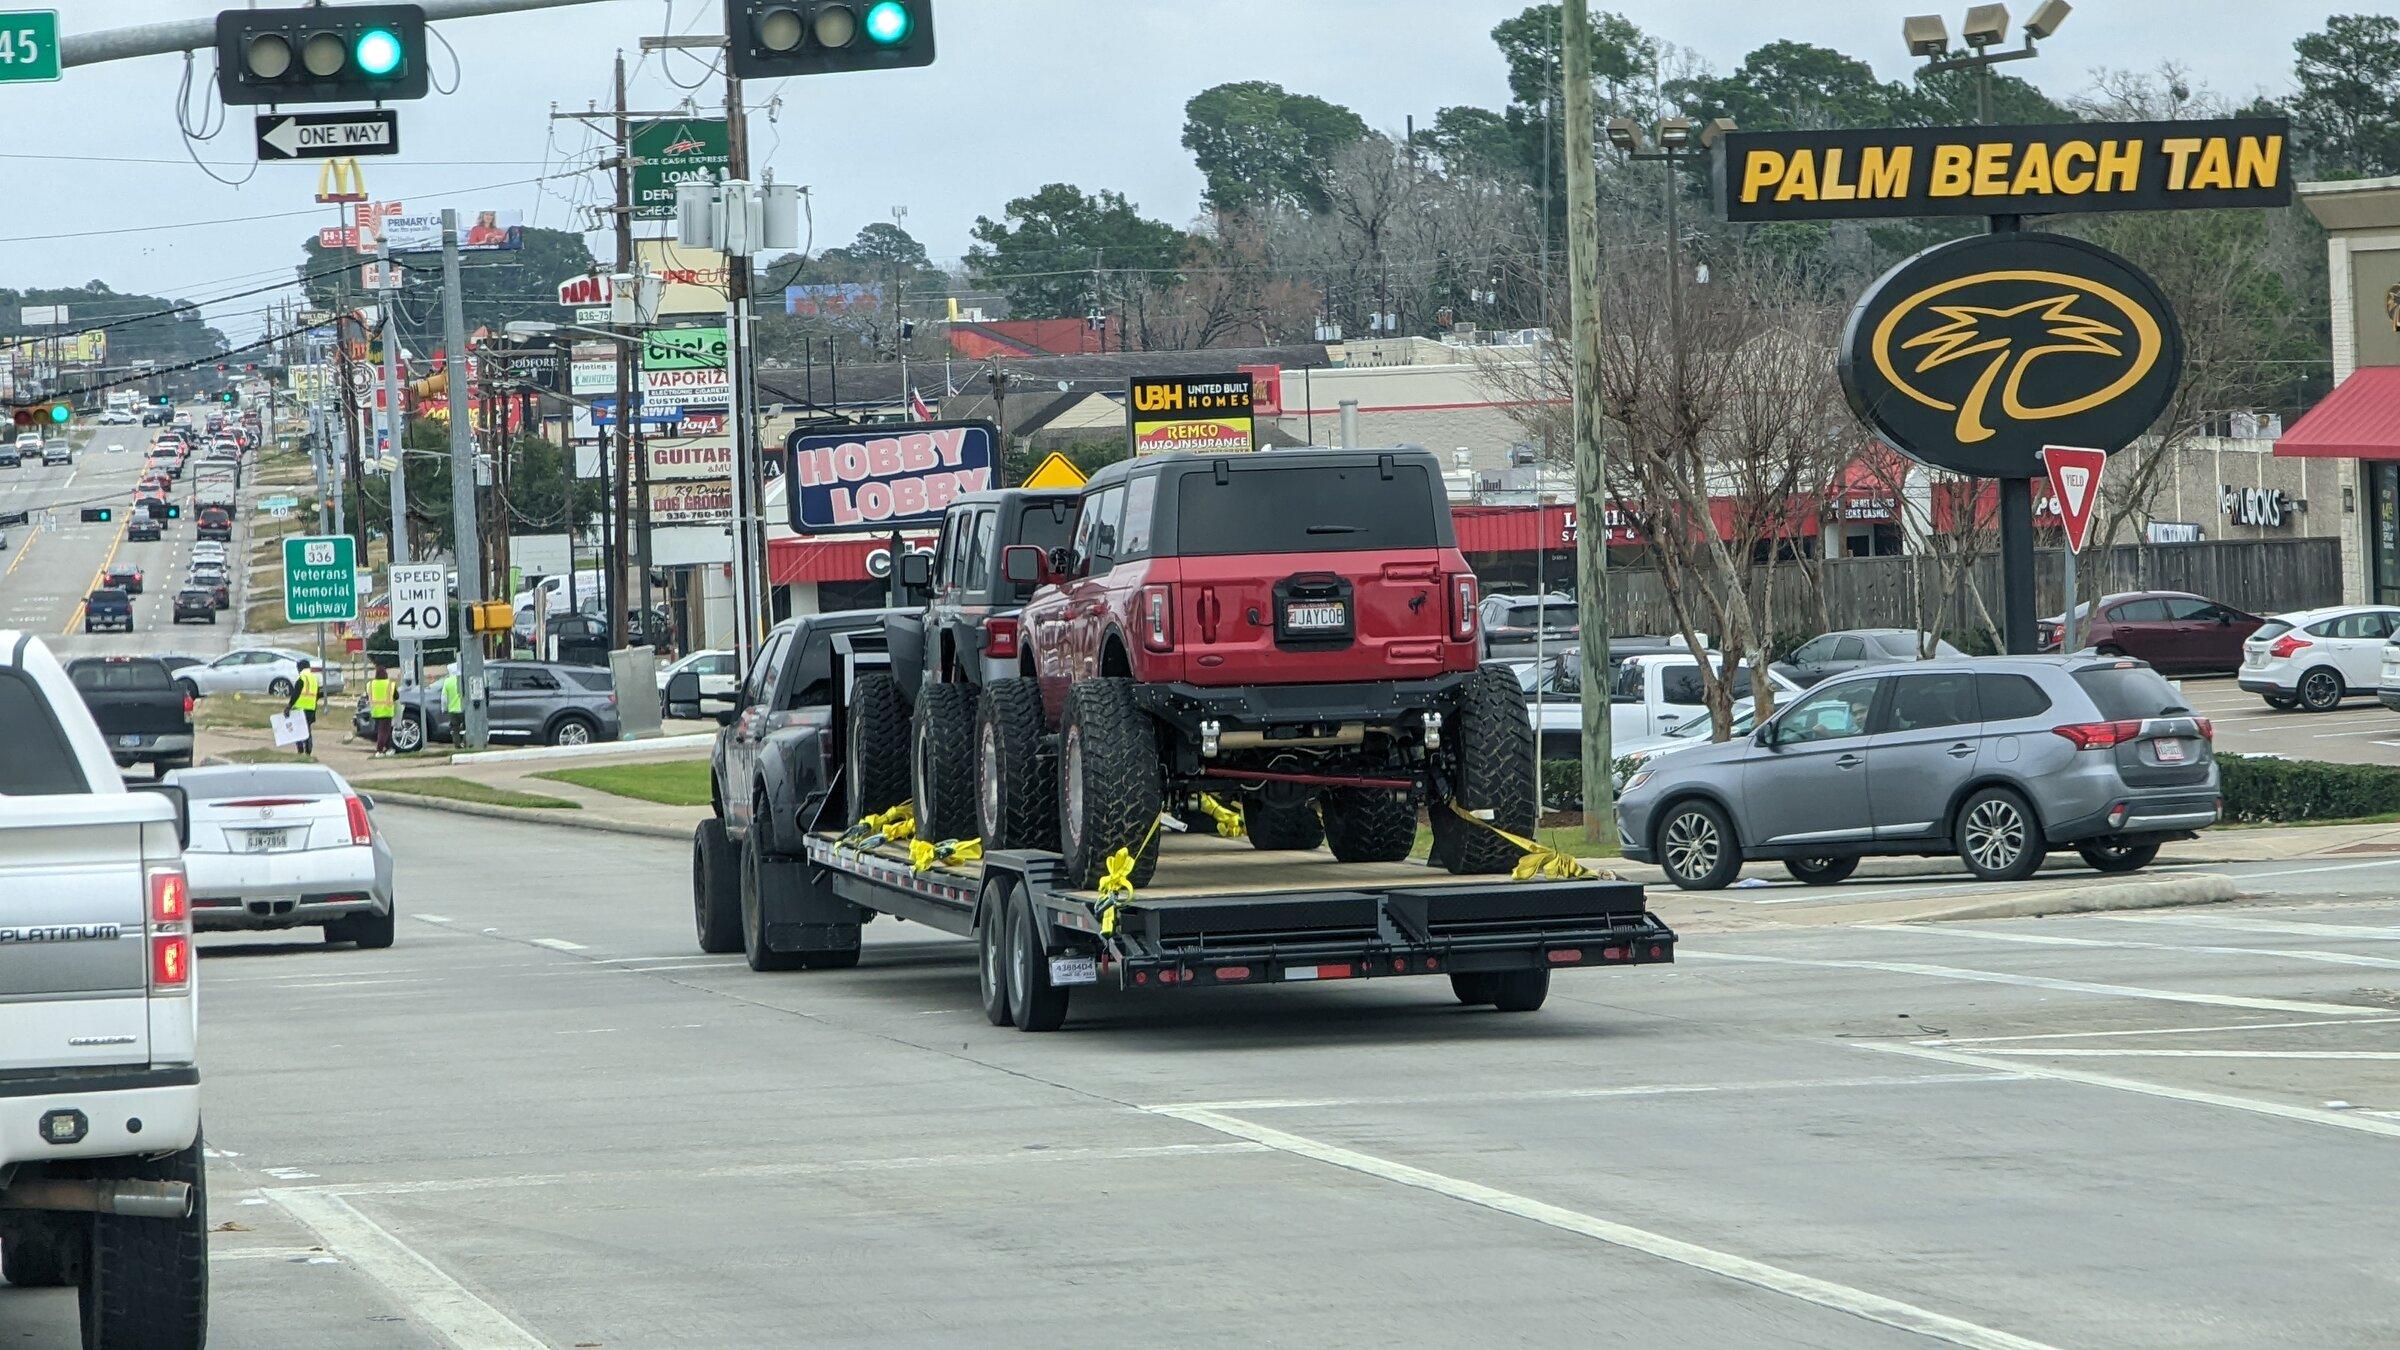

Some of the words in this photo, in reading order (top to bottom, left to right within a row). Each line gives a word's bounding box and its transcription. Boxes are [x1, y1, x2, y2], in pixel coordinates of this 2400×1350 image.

[300, 127, 338, 145] ONE
[345, 124, 384, 142] WAY
[661, 157, 687, 165] CASH
[688, 155, 729, 164] EXPRESS
[1739, 145, 1914, 203] PALM
[1927, 138, 2144, 198] BEACH
[2160, 135, 2283, 191] TAN
[388, 216, 428, 227] PRIMARY
[561, 277, 602, 304] PAPA
[573, 363, 607, 372] Printing
[649, 397, 688, 405] CUSTOM
[1134, 384, 1183, 411] UBH
[1188, 383, 1222, 395] UNITED
[1223, 382, 1249, 394] BUILT
[1188, 395, 1250, 409] HOMES
[1167, 424, 1219, 440] REMCO
[1140, 440, 1174, 450] AUTO
[1176, 437, 1248, 448] INSURANCE
[654, 447, 732, 465] GUITAR
[797, 428, 967, 487] HOBBY
[2065, 474, 2085, 487] YIELD
[830, 466, 992, 525] LOBBY
[1626, 528, 1635, 539] &
[308, 552, 332, 563] 336
[293, 569, 348, 581] Veterans
[394, 570, 441, 583] SPEED
[292, 584, 350, 598] Memorial
[399, 589, 436, 600] LIMIT
[296, 601, 348, 617] Highway
[397, 606, 442, 630] 40
[1298, 608, 1344, 625] JAYCOB
